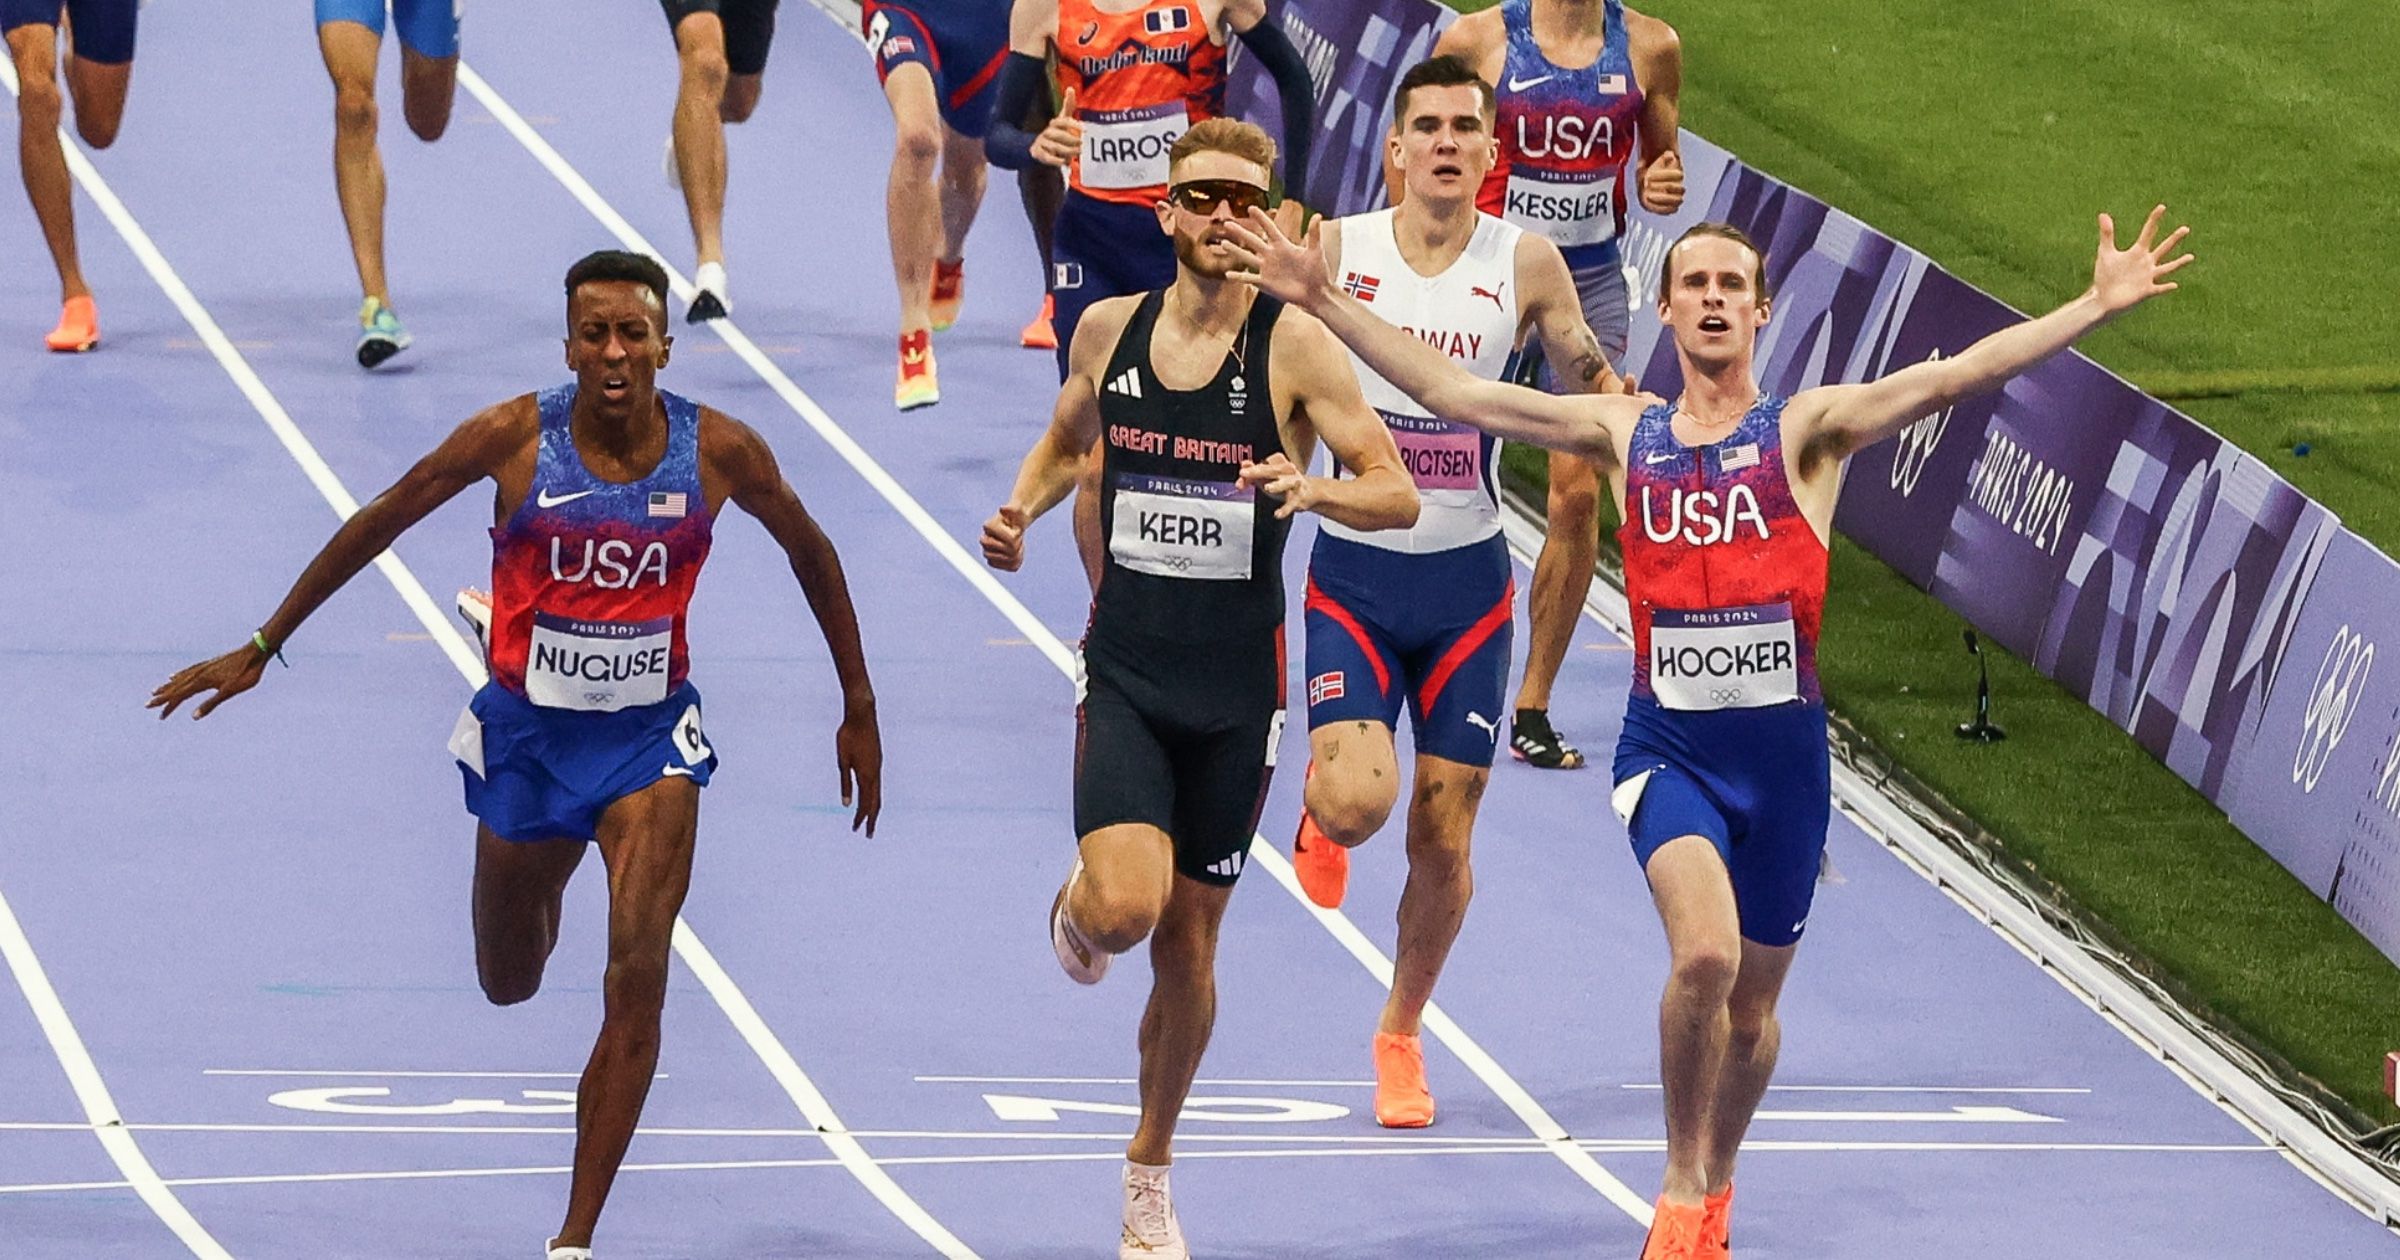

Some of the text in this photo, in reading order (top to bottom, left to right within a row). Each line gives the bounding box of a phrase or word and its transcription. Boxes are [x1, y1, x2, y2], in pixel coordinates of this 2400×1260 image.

[1091, 131, 1177, 162] LAROS
[1517, 114, 1614, 160] USA
[1507, 188, 1609, 222] KESSLER
[1401, 326, 1482, 360] WAY
[1109, 423, 1253, 465] GREAT BRITAIN
[1147, 480, 1219, 497] PARIS 2024
[1641, 483, 1770, 546] USA
[2012, 460, 2074, 557] 2024
[1139, 510, 1223, 548] KERR
[551, 536, 668, 590] USA
[570, 622, 607, 634] PARIS
[1684, 611, 1758, 624] PARIS 2024
[535, 642, 668, 682] NUGUSE
[1657, 639, 1793, 678] HOCKER
[684, 719, 699, 753] 6
